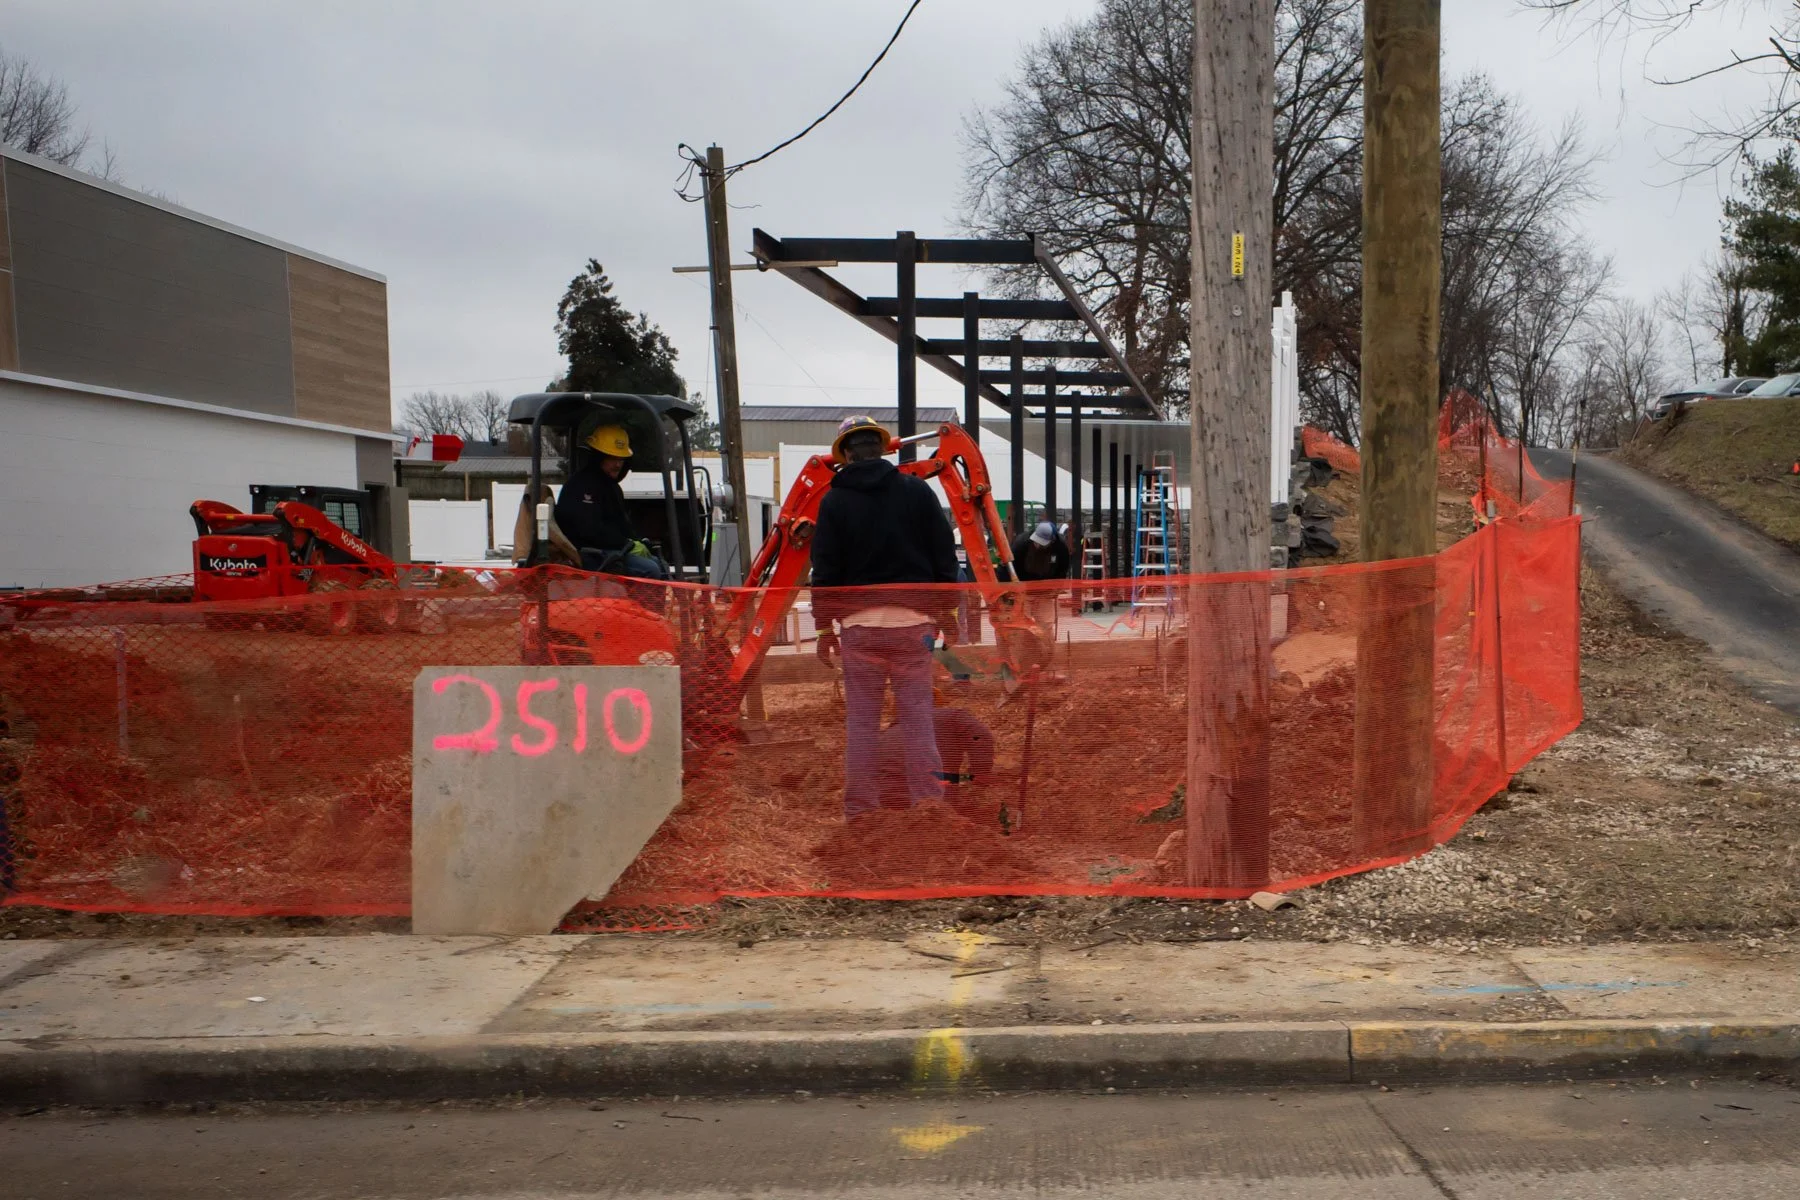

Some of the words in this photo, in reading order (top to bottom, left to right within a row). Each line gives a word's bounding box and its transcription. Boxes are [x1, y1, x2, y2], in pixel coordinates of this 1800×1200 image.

[341, 531, 367, 557] Kubota
[209, 558, 257, 570] Kubota
[432, 673, 653, 757] 2510
